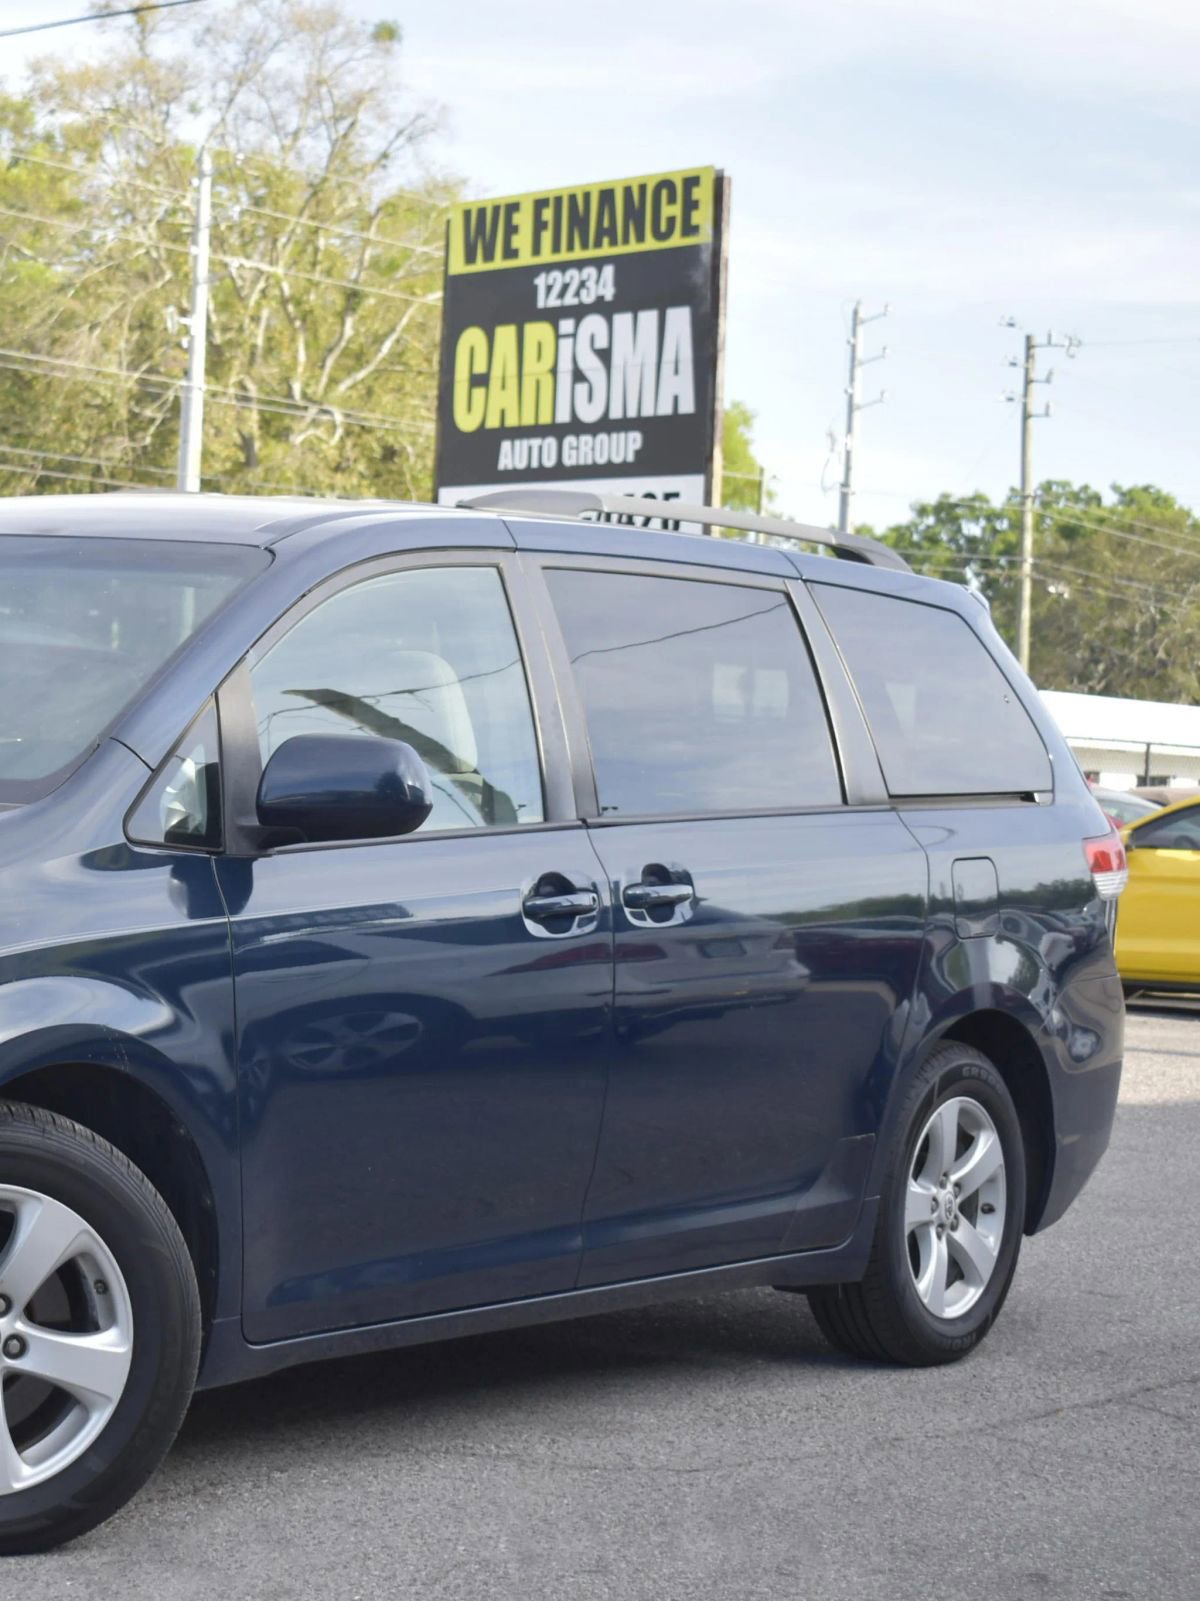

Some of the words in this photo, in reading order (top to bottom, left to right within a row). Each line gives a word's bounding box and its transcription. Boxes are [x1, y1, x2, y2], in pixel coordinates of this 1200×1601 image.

[462, 202, 521, 266] WE
[531, 175, 701, 257] FINANCE
[533, 263, 616, 309] 12234
[453, 305, 696, 433] CARiSMA
[497, 436, 558, 471] AUTO
[561, 430, 643, 467] GROUP
